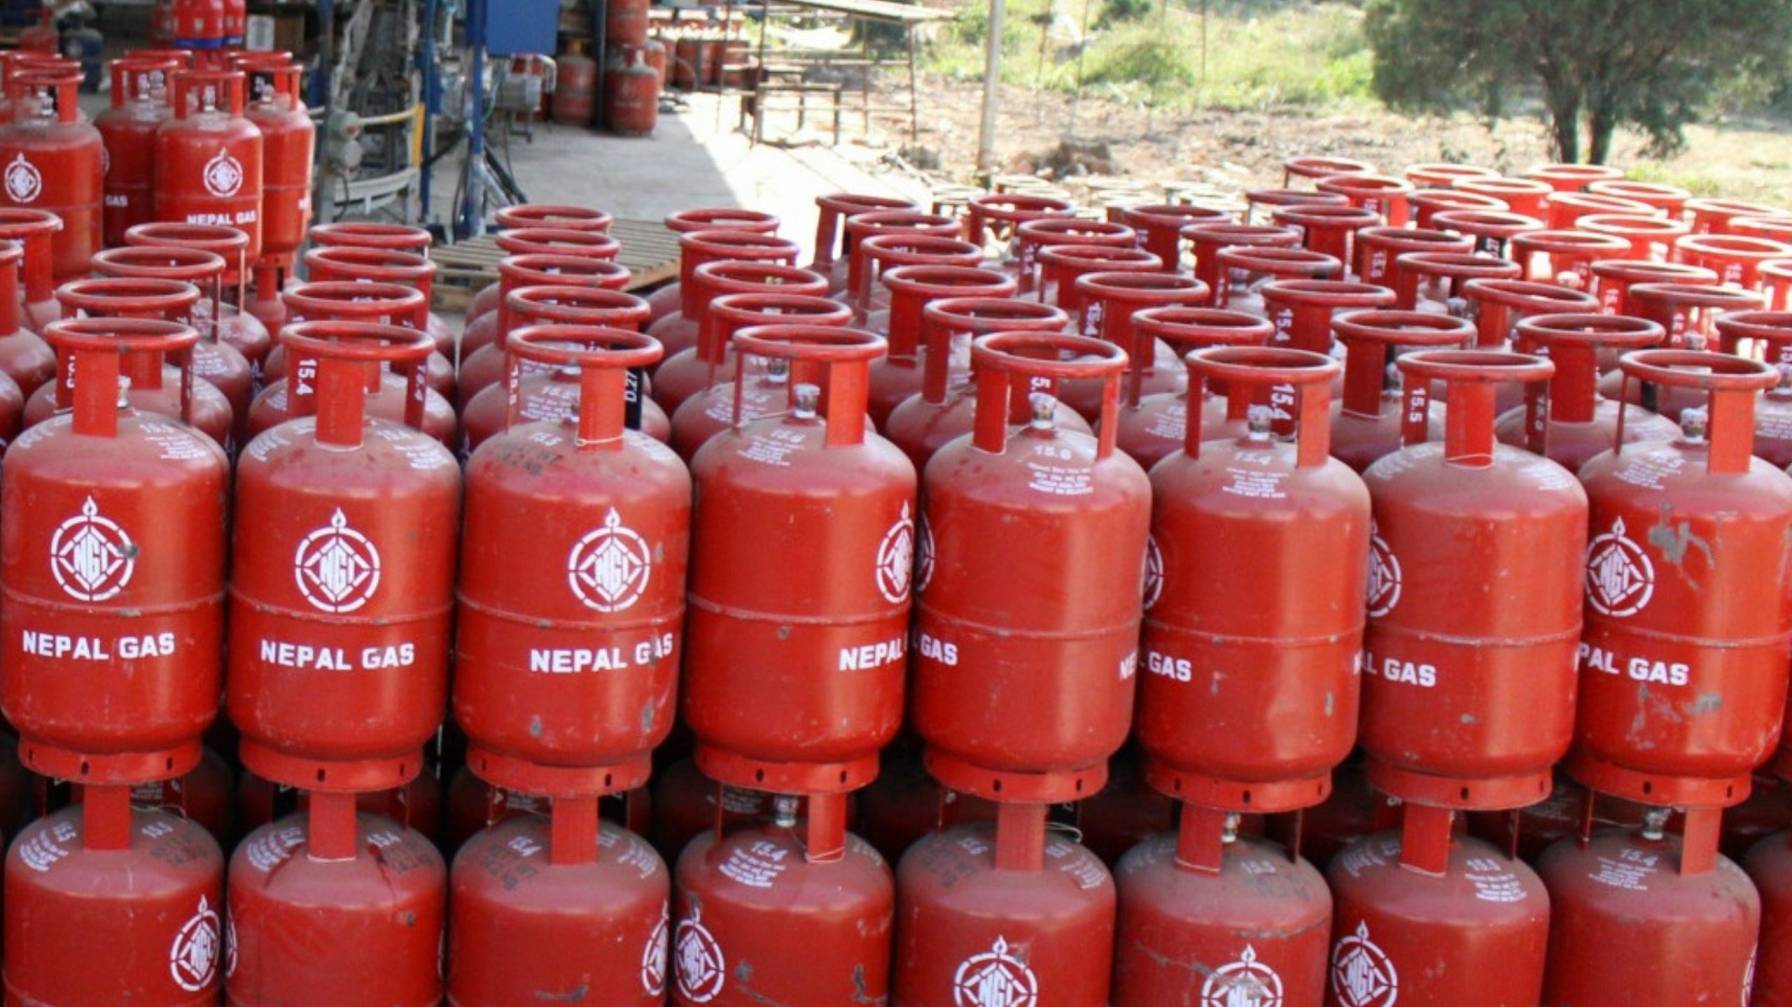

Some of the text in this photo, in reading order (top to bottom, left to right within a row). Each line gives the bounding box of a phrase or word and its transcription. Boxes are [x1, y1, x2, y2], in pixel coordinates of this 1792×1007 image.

[187, 213, 233, 225] NEPAL
[1276, 308, 1293, 342] 15.4
[297, 359, 317, 396] 15.4
[1271, 384, 1295, 420] 15.4
[1408, 387, 1427, 424] 15.5
[22, 630, 175, 660] NEPAL GAS
[261, 639, 415, 671] NEPAL GAS
[530, 632, 673, 673] NEPAL GAS
[838, 639, 902, 671] NEPAL
[920, 635, 958, 666] GAS
[1148, 652, 1192, 682] GAS
[1383, 657, 1437, 687] GAS
[1578, 641, 1690, 687] PAL GAS
